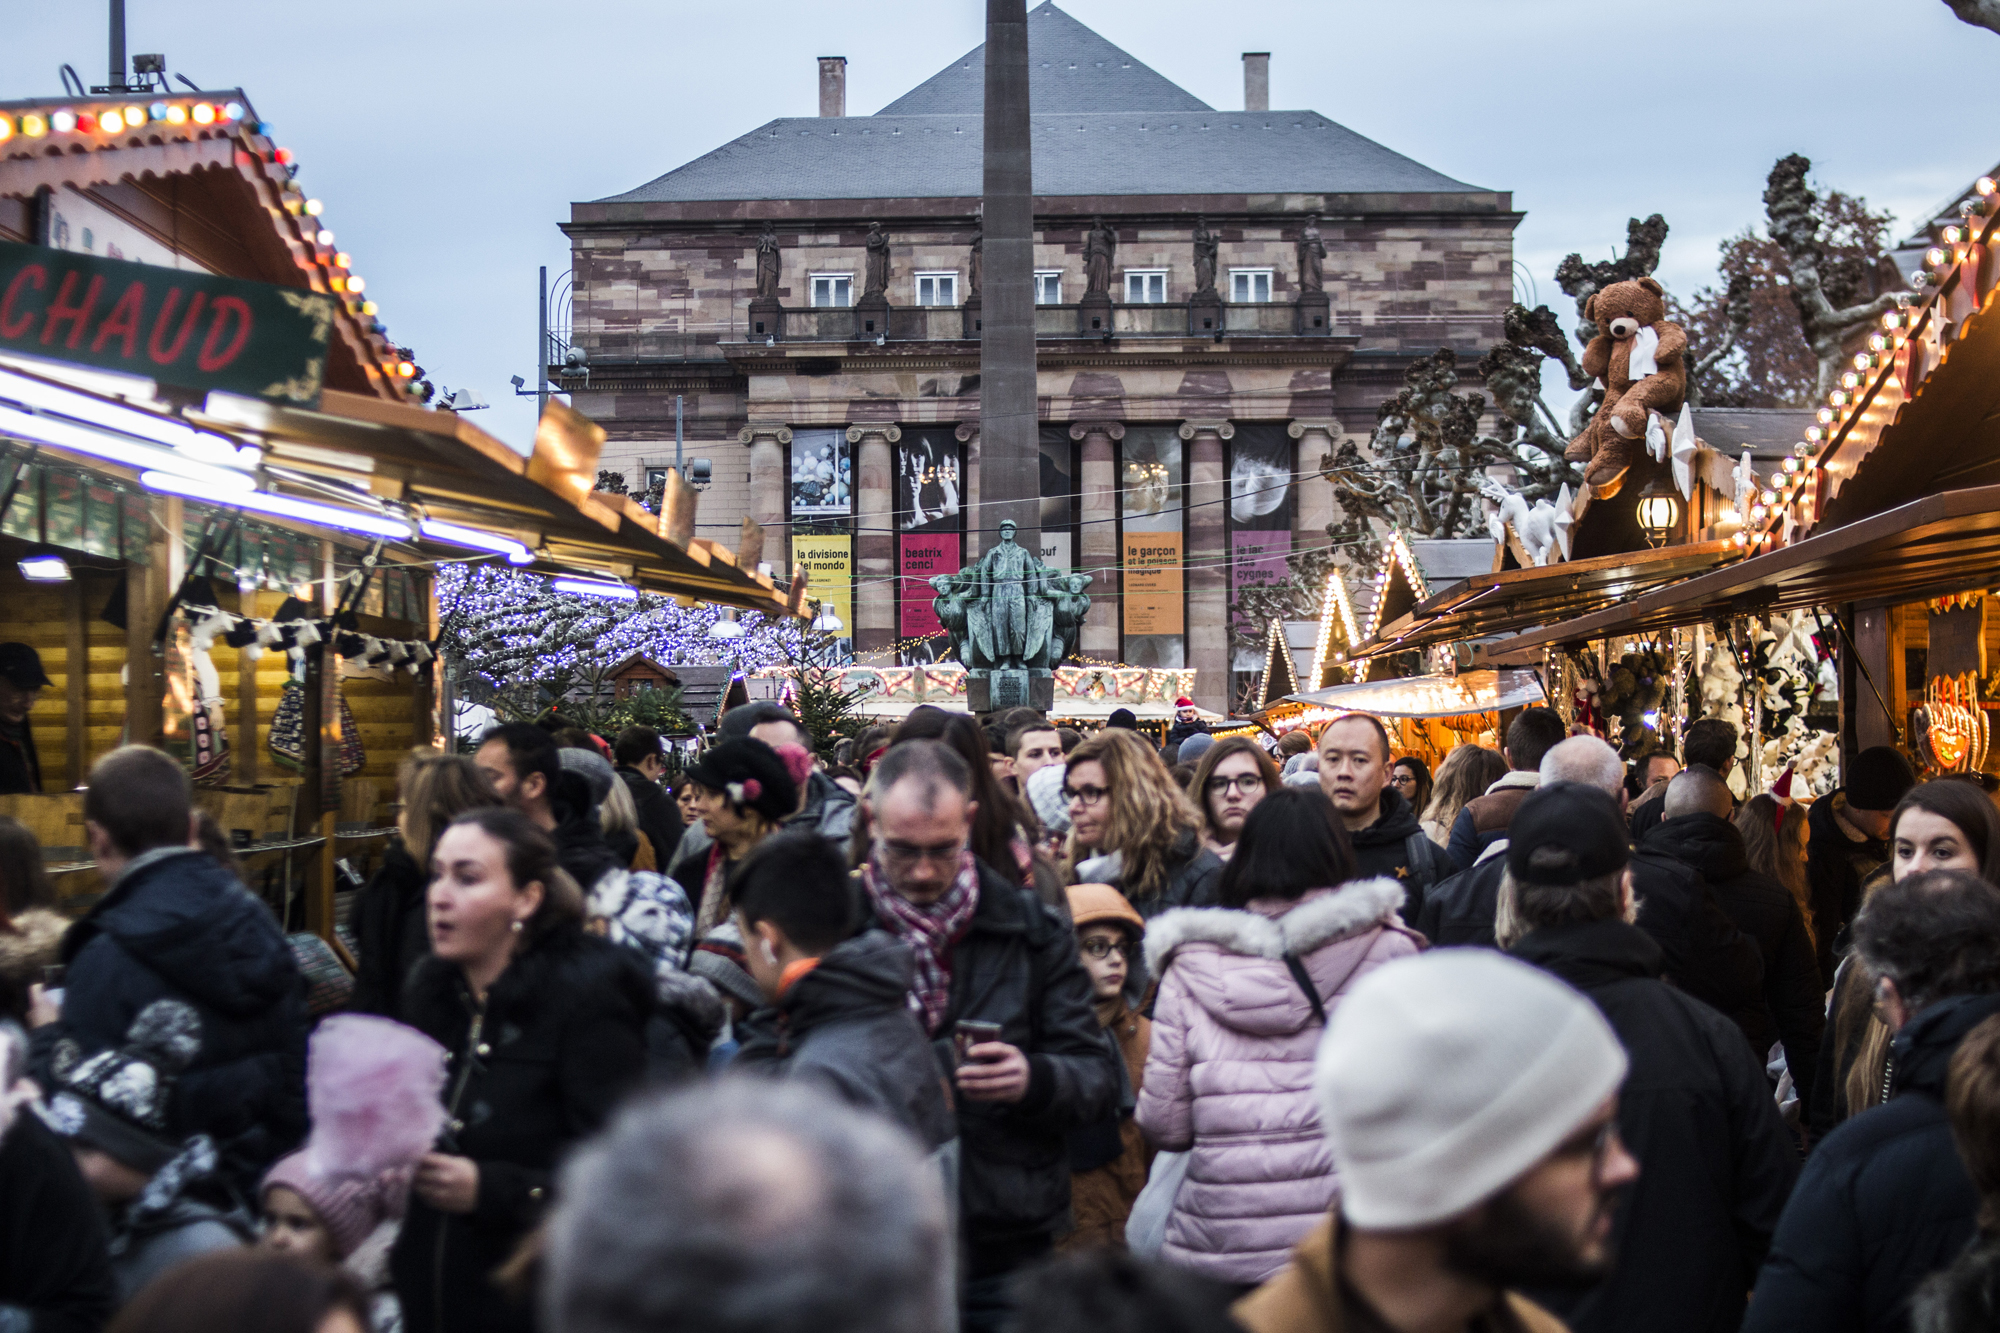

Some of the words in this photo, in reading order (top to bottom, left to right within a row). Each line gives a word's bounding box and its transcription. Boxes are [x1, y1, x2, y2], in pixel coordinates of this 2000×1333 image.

[0, 264, 253, 372] CHAUD
[797, 549, 806, 559] la
[808, 549, 849, 559] divisione
[905, 547, 942, 558] beatrix
[1128, 545, 1138, 556] le
[1140, 546, 1176, 558] garçon
[1236, 544, 1246, 554] le
[1248, 544, 1264, 555] lac
[800, 560, 811, 570] el
[814, 560, 845, 570] mondo
[905, 558, 933, 569] cenci
[1138, 557, 1145, 566] le
[1147, 558, 1178, 567] poisson
[1236, 556, 1256, 567] des
[1128, 566, 1162, 576] magique
[1236, 570, 1274, 580] cygnes
